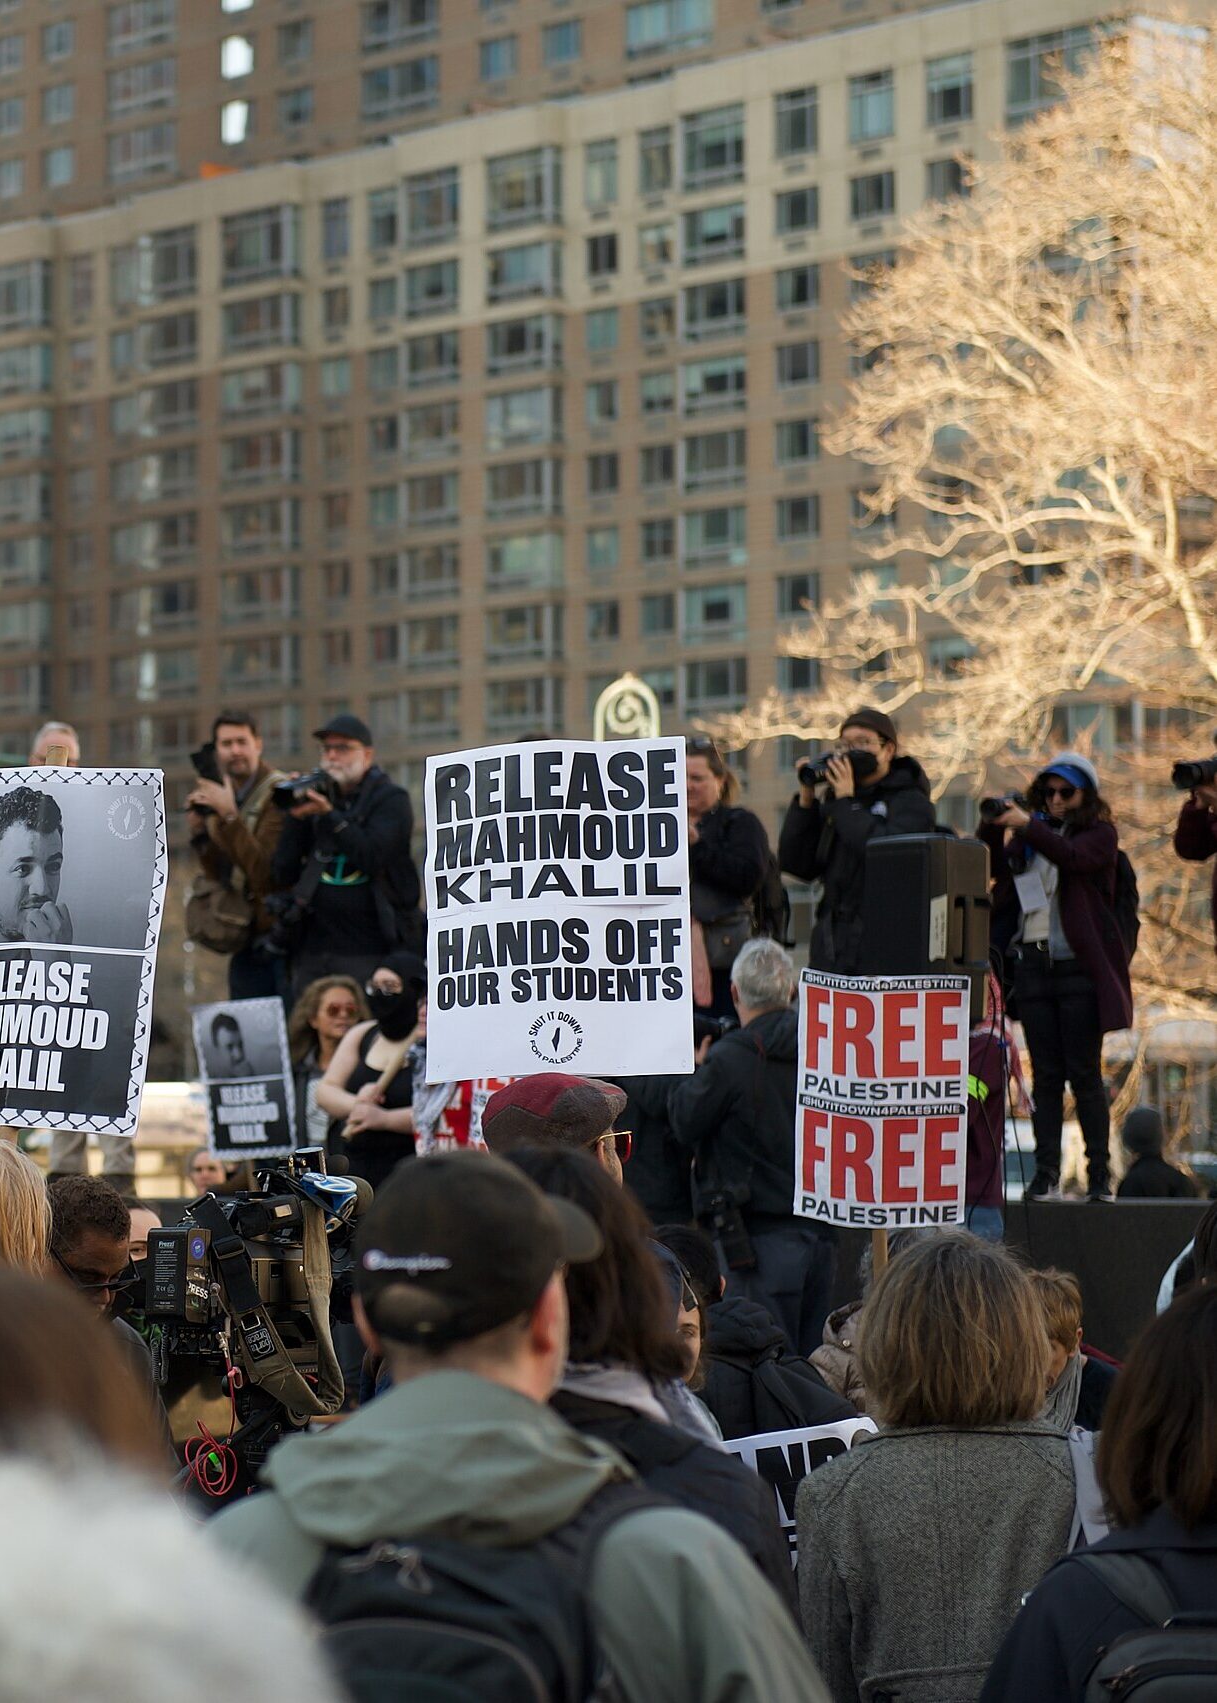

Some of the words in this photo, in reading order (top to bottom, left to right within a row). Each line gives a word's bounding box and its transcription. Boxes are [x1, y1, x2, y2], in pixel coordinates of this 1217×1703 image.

[435, 749, 678, 825] RELEASE
[434, 813, 678, 871] MAHMOUD
[435, 863, 681, 909] KHALIL
[438, 918, 589, 975] HANDS
[606, 919, 681, 965] OFF
[438, 972, 500, 1010] OUR
[511, 967, 683, 1003] STUDENTS
[529, 1015, 546, 1037] SHUT
[546, 1011, 555, 1021] IT
[557, 1011, 583, 1035] DOWN!
[806, 986, 962, 1078] FREE
[530, 1039, 542, 1058] FOR
[542, 1038, 583, 1064] PALESTINE
[805, 1074, 961, 1100] PALESTINE
[803, 1109, 959, 1203] FREE
[802, 1197, 957, 1225] PALESTINE
